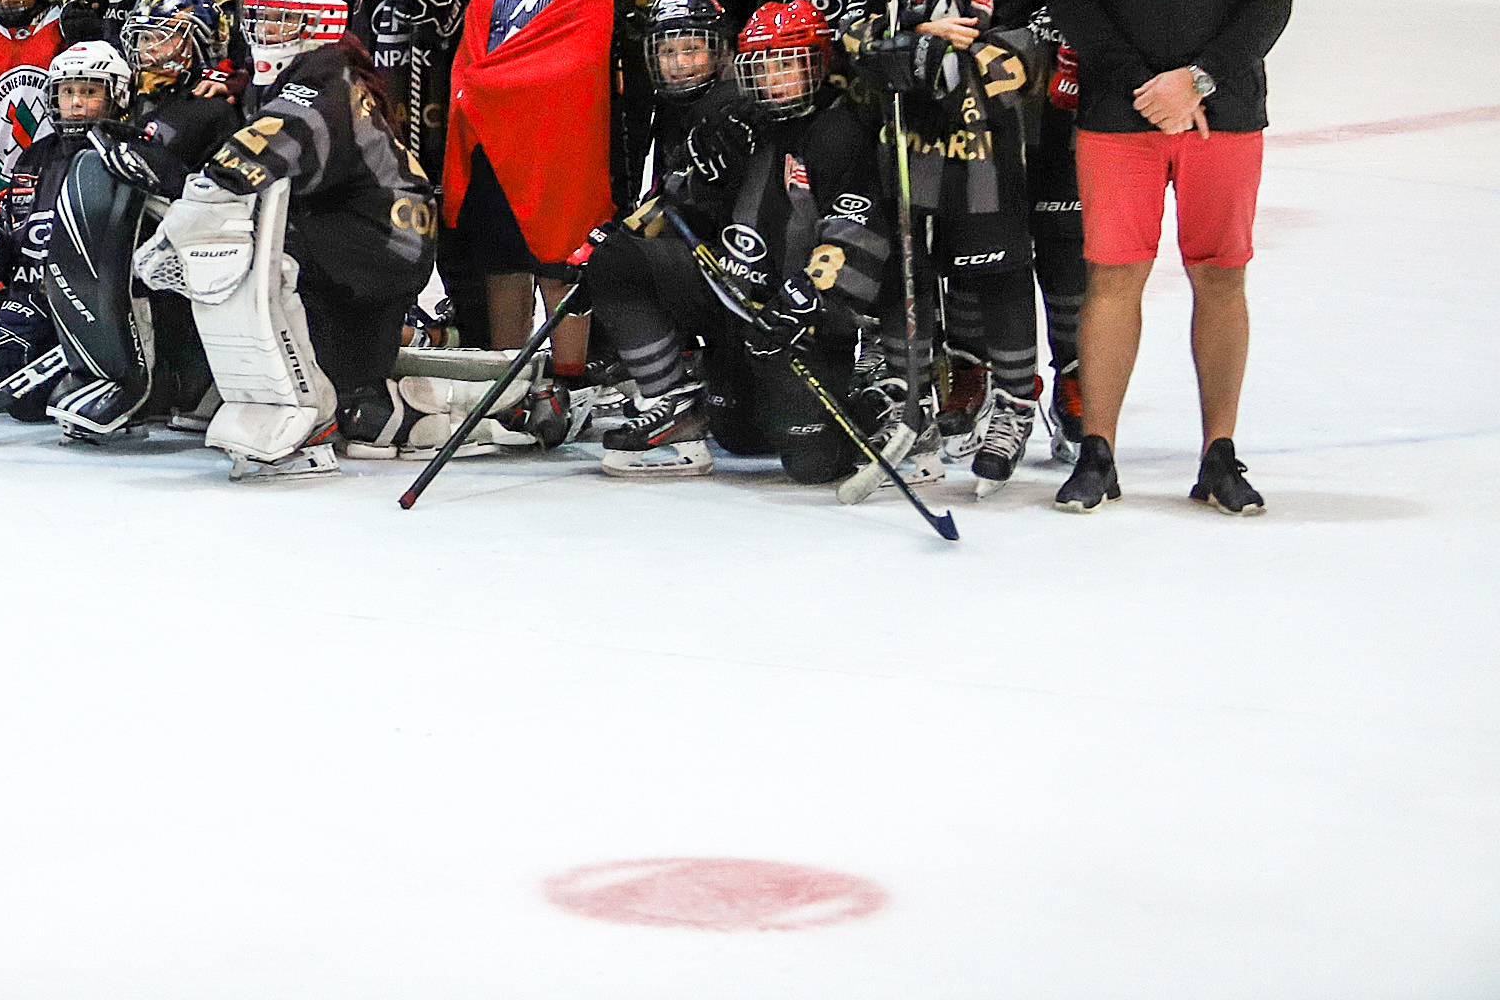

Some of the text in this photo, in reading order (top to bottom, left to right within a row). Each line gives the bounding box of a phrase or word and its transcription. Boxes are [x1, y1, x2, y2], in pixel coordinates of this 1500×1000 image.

[373, 50, 433, 68] NPAK
[1034, 200, 1084, 213] BAUE
[189, 248, 238, 258] BAUER
[953, 250, 1006, 267] CCM
[717, 255, 769, 286] ANPCK
[804, 243, 847, 291] 8
[48, 263, 96, 324] BAUER
[0, 300, 36, 319] UER
[280, 329, 311, 394] BAUER
